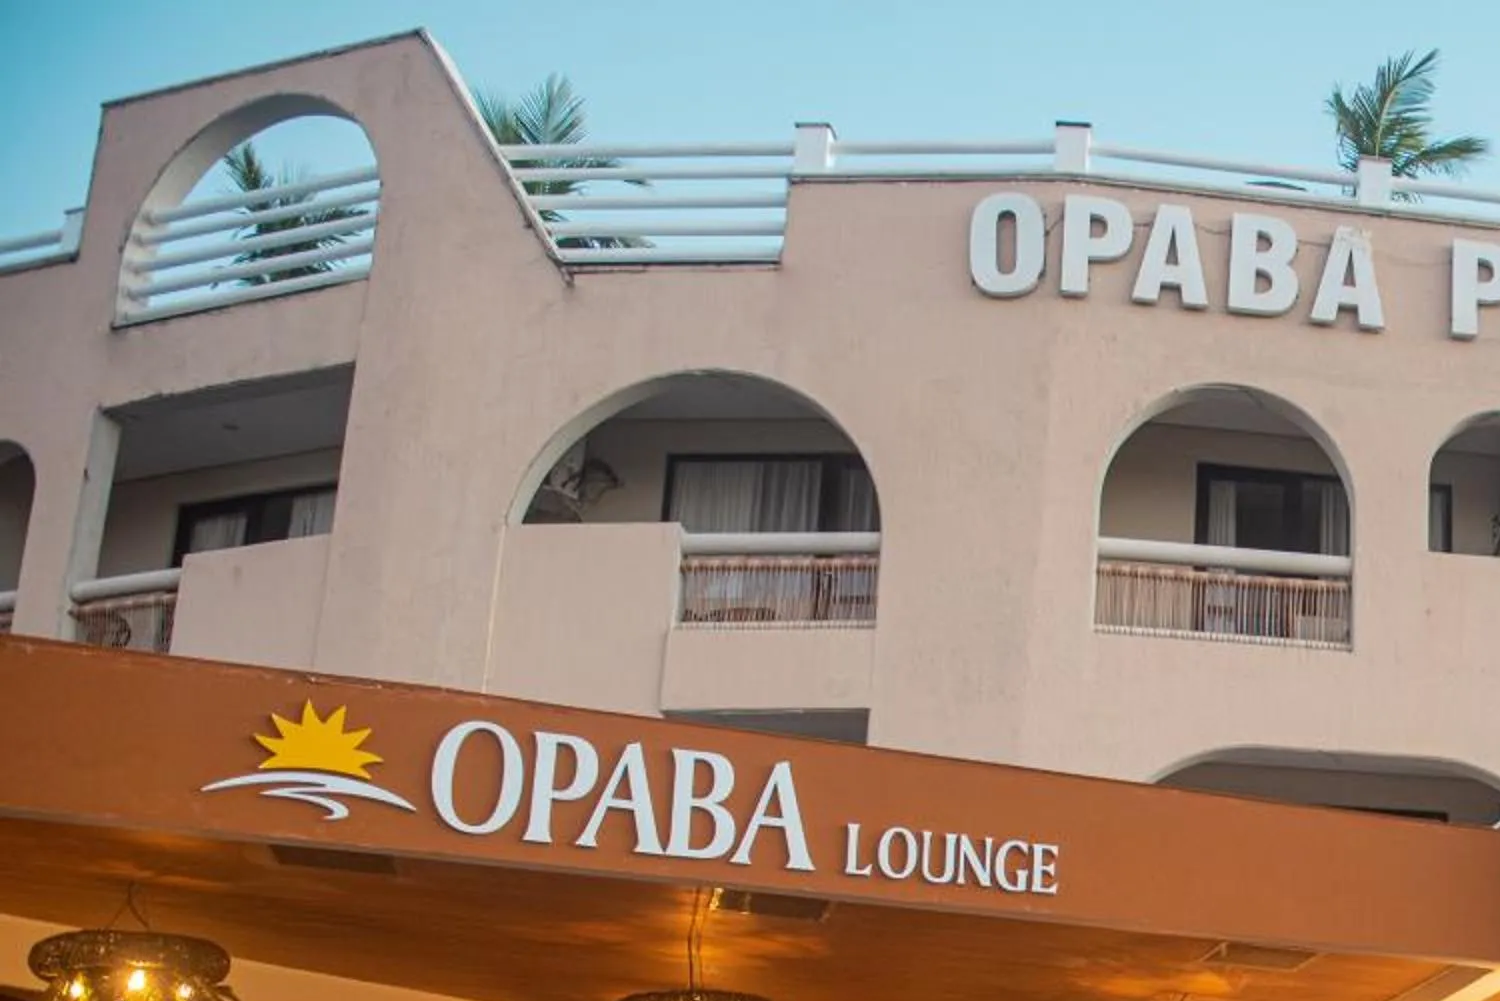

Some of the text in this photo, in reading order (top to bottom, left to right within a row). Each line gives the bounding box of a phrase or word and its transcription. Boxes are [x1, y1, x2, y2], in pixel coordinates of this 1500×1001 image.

[969, 191, 1385, 333] OPABA
[430, 720, 1060, 895] OPABA LOUNGE
